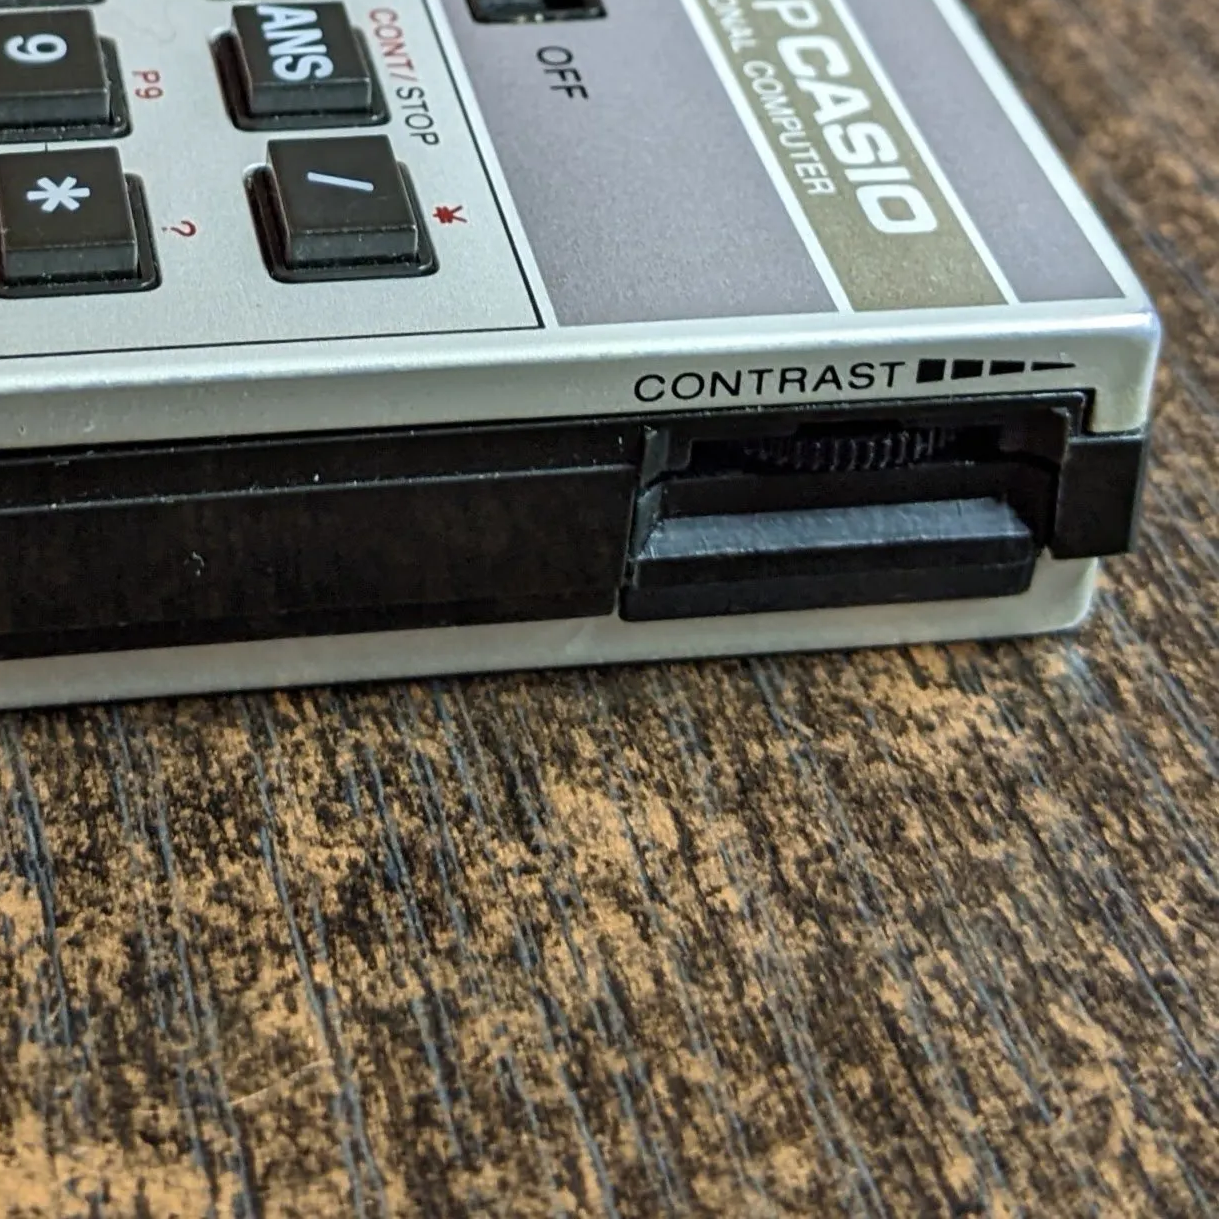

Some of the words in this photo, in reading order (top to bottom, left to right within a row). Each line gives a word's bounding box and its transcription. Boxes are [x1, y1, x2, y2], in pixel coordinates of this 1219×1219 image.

[5, 32, 68, 65] 9
[256, 5, 335, 83] ANS
[132, 69, 164, 101] P9
[536, 45, 589, 101] OFF
[742, 60, 837, 197] COMPUTER
[776, 34, 939, 235] CASIO
[633, 360, 907, 404] CONTRAST
